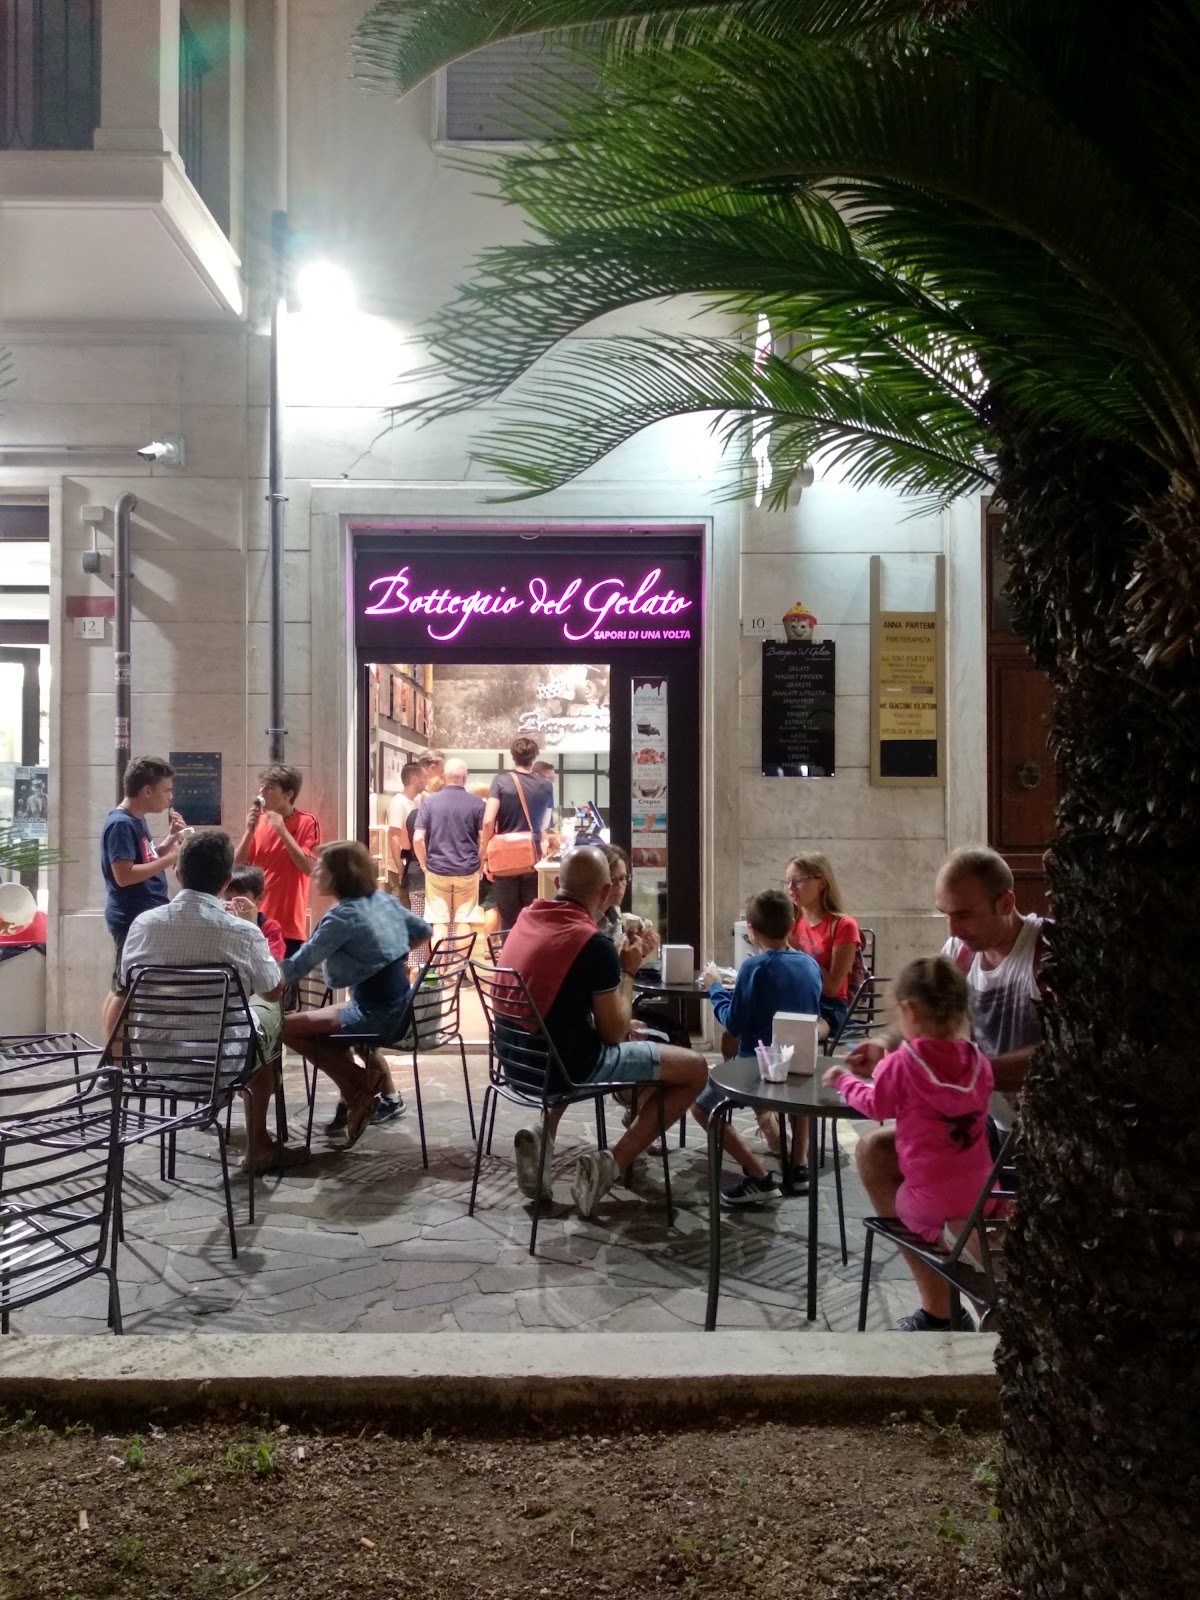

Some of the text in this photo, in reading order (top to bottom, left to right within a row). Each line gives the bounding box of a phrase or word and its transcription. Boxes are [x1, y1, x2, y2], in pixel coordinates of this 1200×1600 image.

[365, 566, 692, 640] Bottegaio del Gelato
[82, 620, 96, 632] 12
[752, 618, 765, 629] 10
[883, 621, 902, 629] ANNA
[593, 630, 691, 640] SAPORI DI UNA VOLTA
